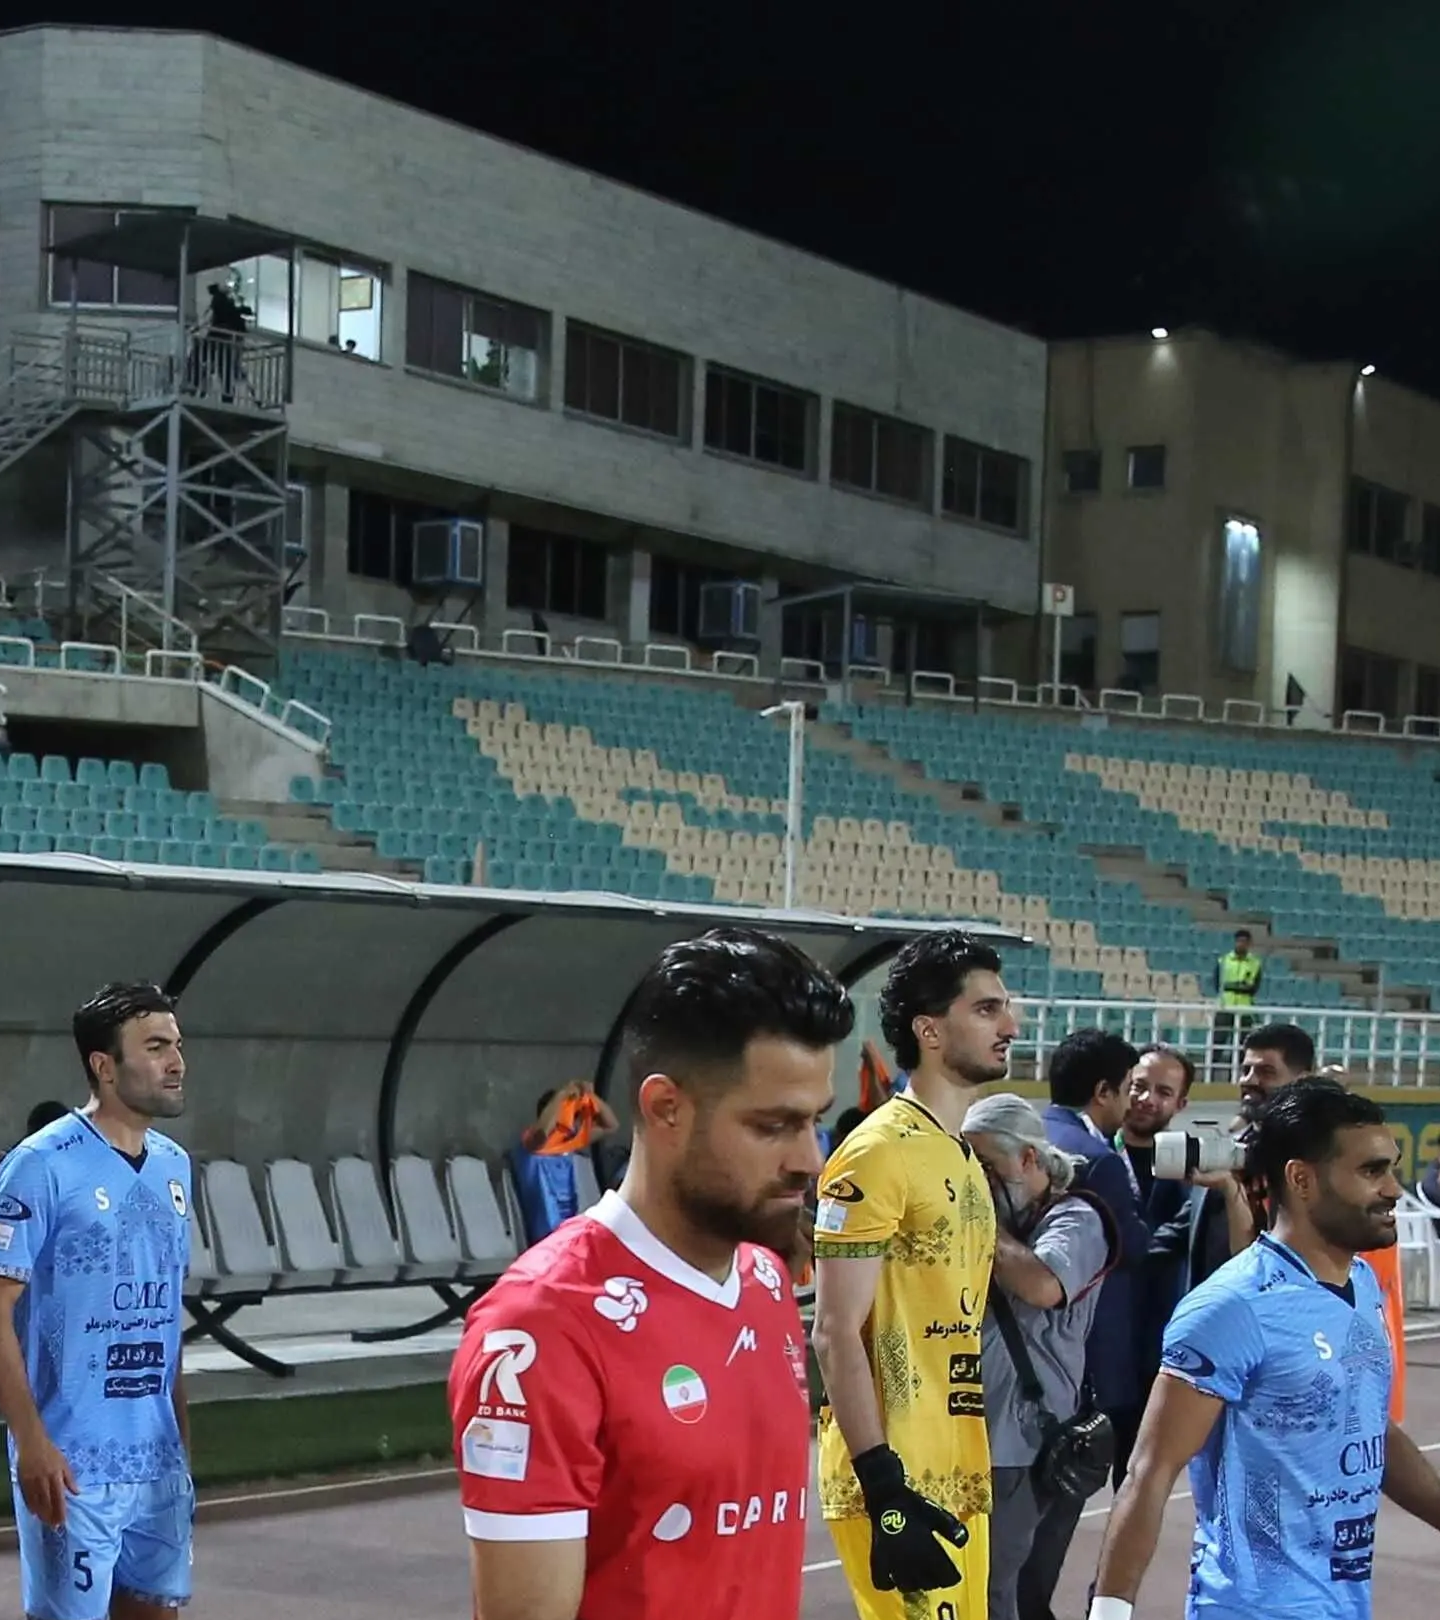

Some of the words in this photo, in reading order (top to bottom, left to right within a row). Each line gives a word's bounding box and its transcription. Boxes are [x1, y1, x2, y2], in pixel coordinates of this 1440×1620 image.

[1312, 1330, 1332, 1360] S
[951, 1357, 981, 1379] ارفع
[477, 1405, 492, 1416] ED
[73, 1551, 93, 1592] 5
